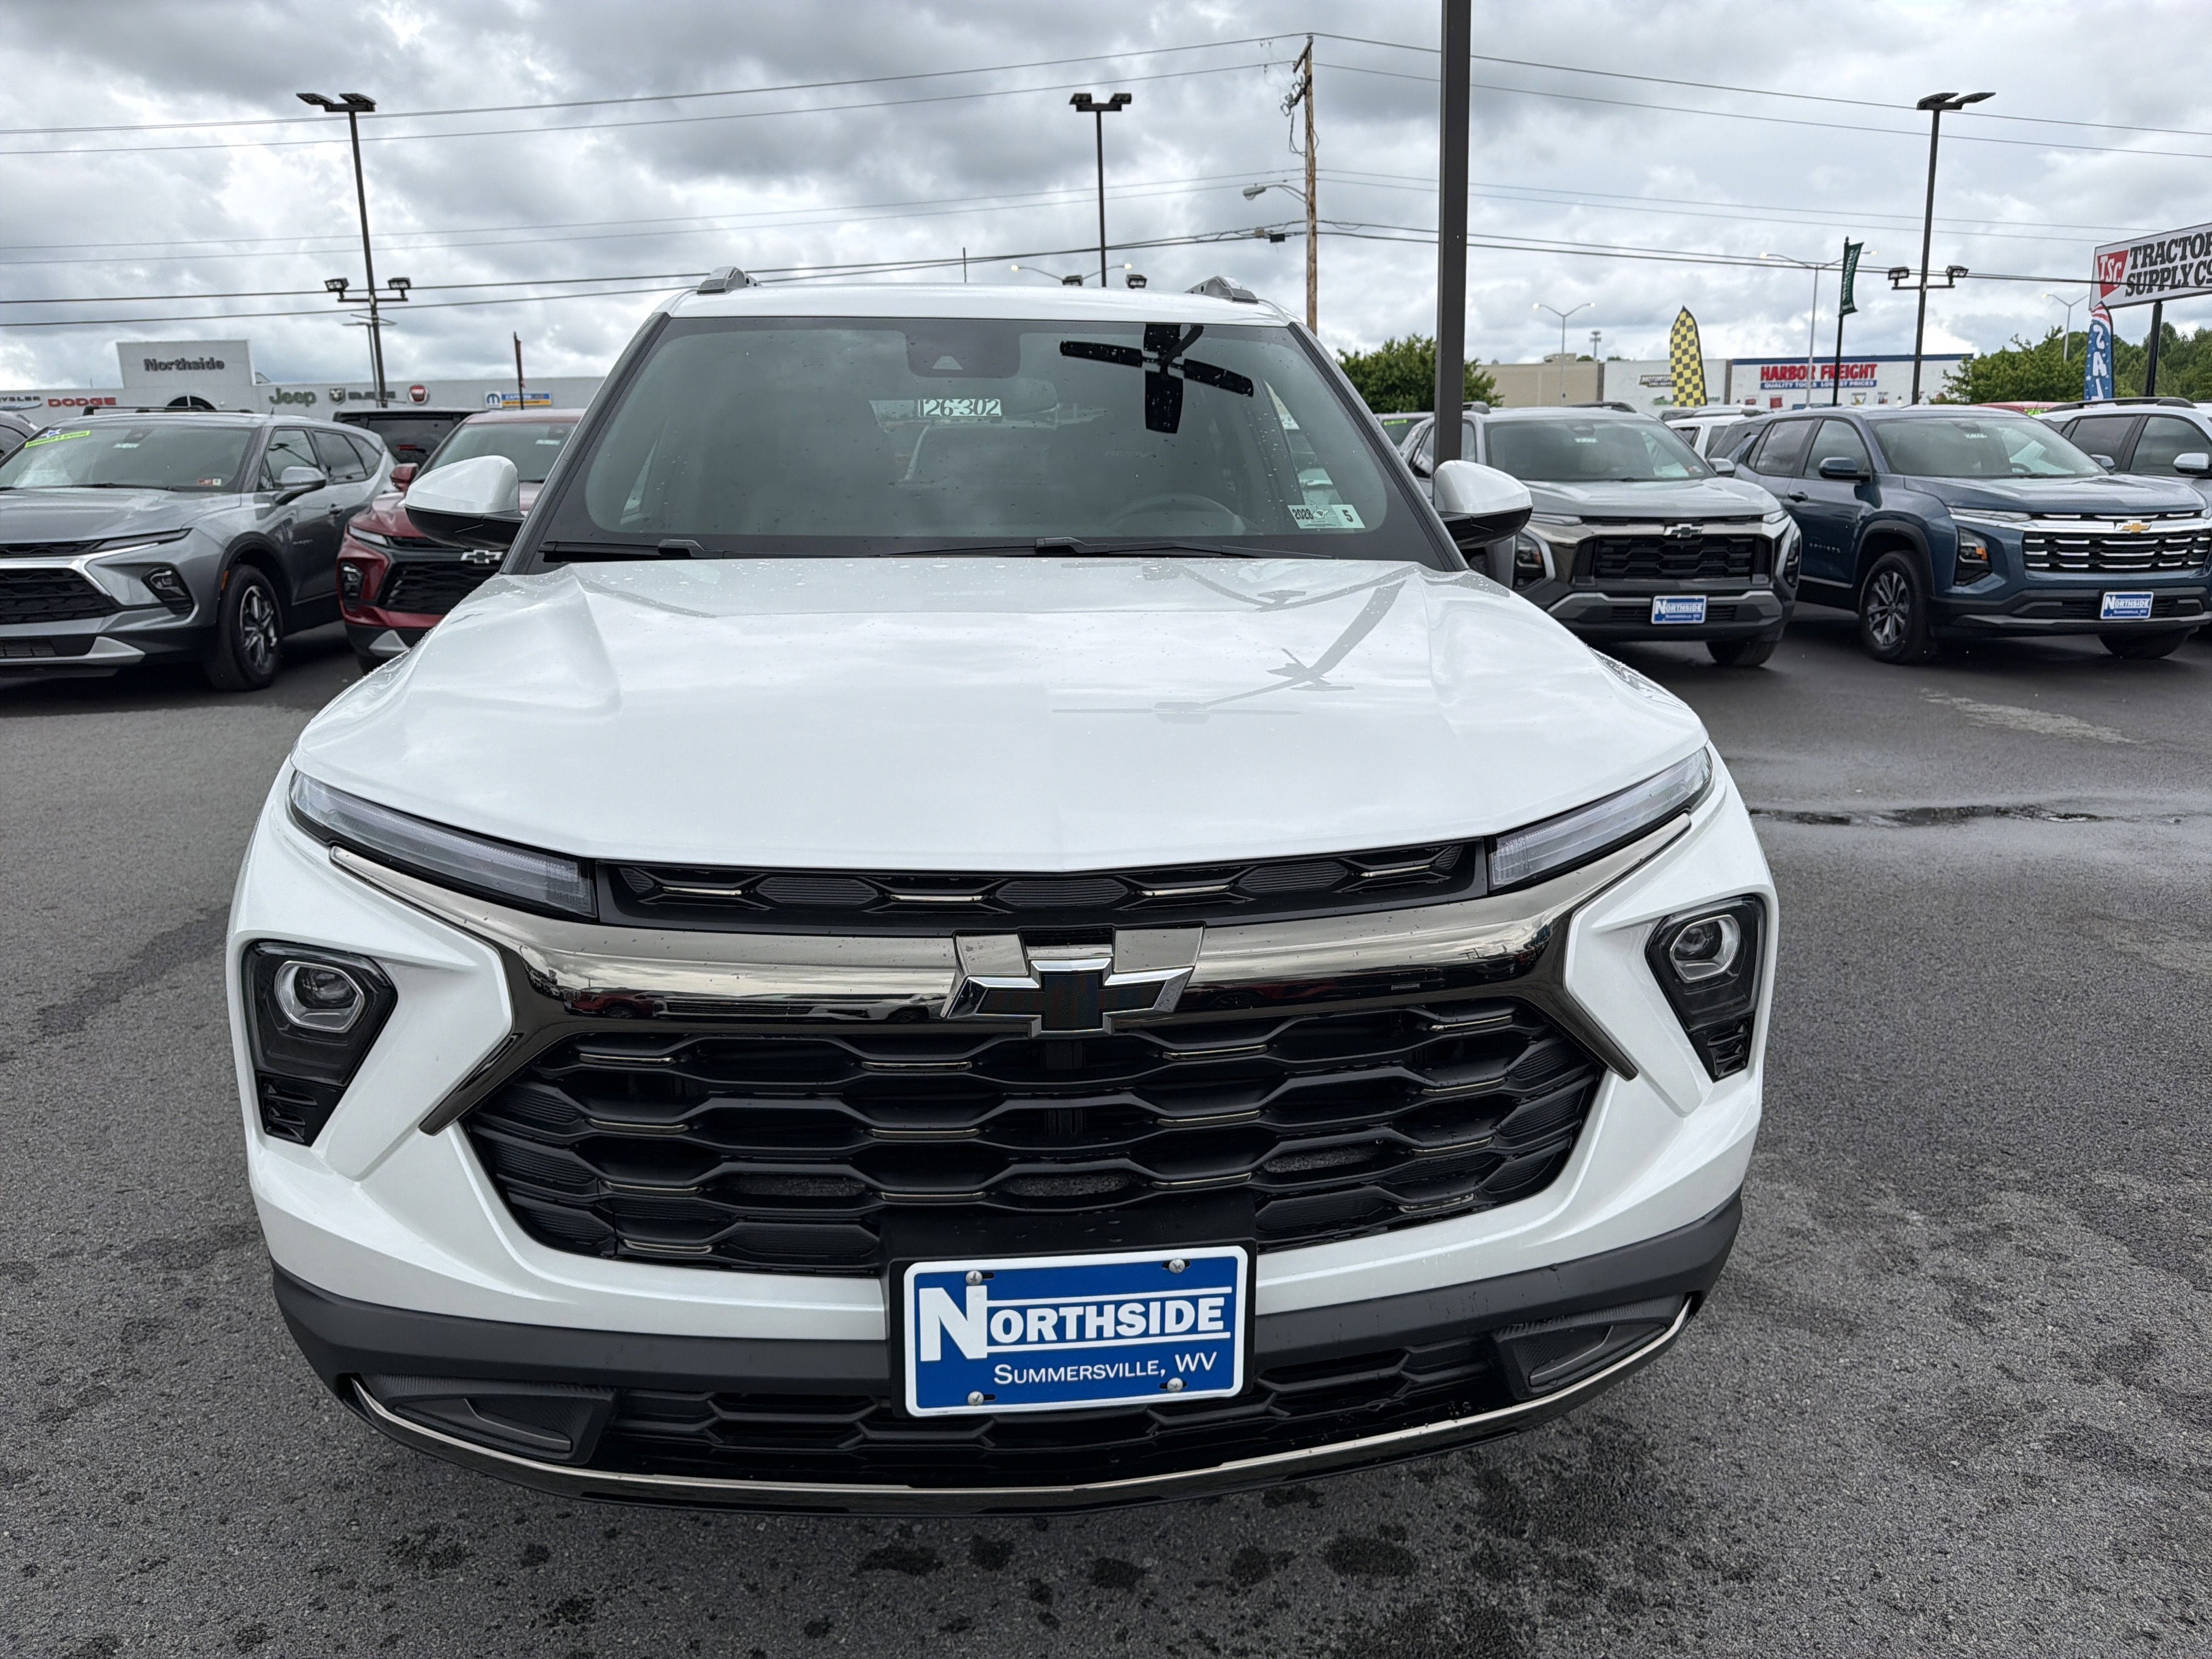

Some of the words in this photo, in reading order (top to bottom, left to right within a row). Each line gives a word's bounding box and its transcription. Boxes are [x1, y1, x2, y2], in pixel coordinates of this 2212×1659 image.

[2100, 256, 2121, 287] TSC
[2125, 262, 2194, 297] SUPPLY
[144, 357, 225, 371] Northside
[1760, 365, 1816, 381] HARBOR
[1820, 364, 1877, 380] FREIGHT
[48, 397, 116, 407] DODGE
[269, 388, 317, 407] Jeep
[1291, 509, 1314, 520] 2028
[1342, 509, 1353, 522] 5
[1655, 600, 1702, 614] NORTHSIDE
[2104, 596, 2150, 610] NORTHSIDE
[919, 1285, 1225, 1362] NORTHSIDE
[994, 1359, 1166, 1386] SUMMERSVILLE,
[1175, 1351, 1217, 1373] WV
